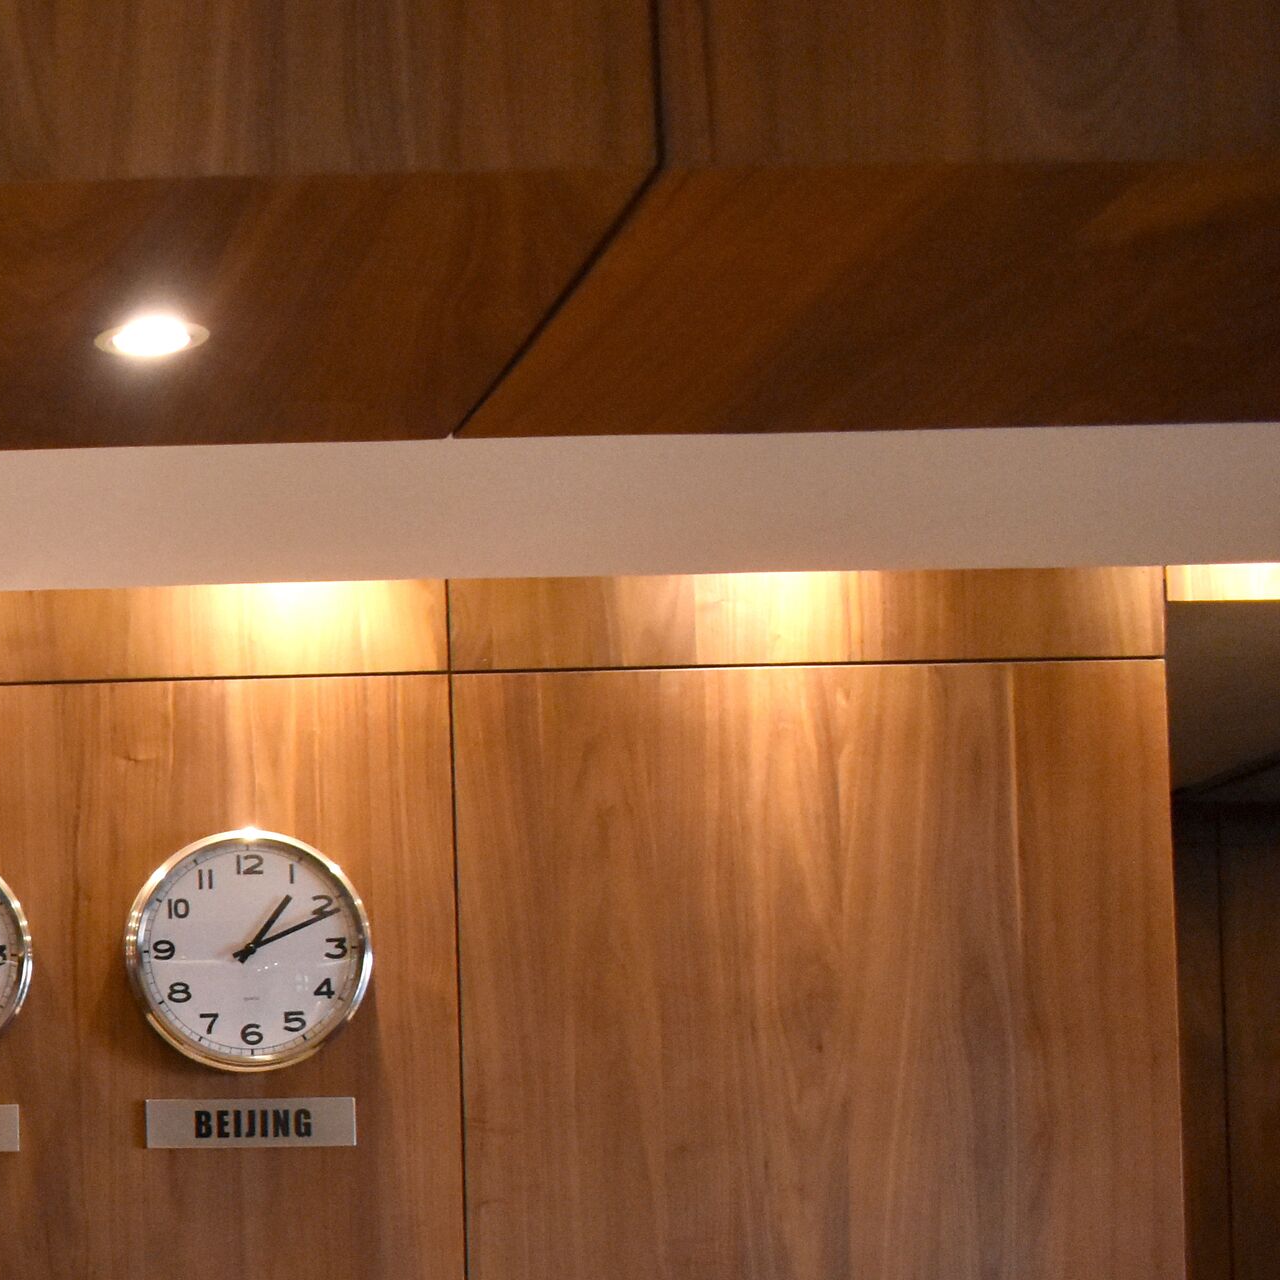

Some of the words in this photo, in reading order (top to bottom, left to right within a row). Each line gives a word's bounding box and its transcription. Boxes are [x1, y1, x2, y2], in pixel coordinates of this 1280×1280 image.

[236, 854, 264, 875] 12
[289, 863, 295, 885] 1
[197, 868, 213, 890] 11
[167, 898, 190, 920] 10
[312, 895, 334, 917] 2
[152, 939, 176, 961] 9
[324, 936, 348, 960] 3
[167, 982, 192, 1004] 8
[313, 977, 336, 1000] 4
[199, 1012, 219, 1035] 7
[283, 1010, 307, 1033] 5
[240, 1023, 264, 1046] 6
[193, 1107, 313, 1140] BEIJING
